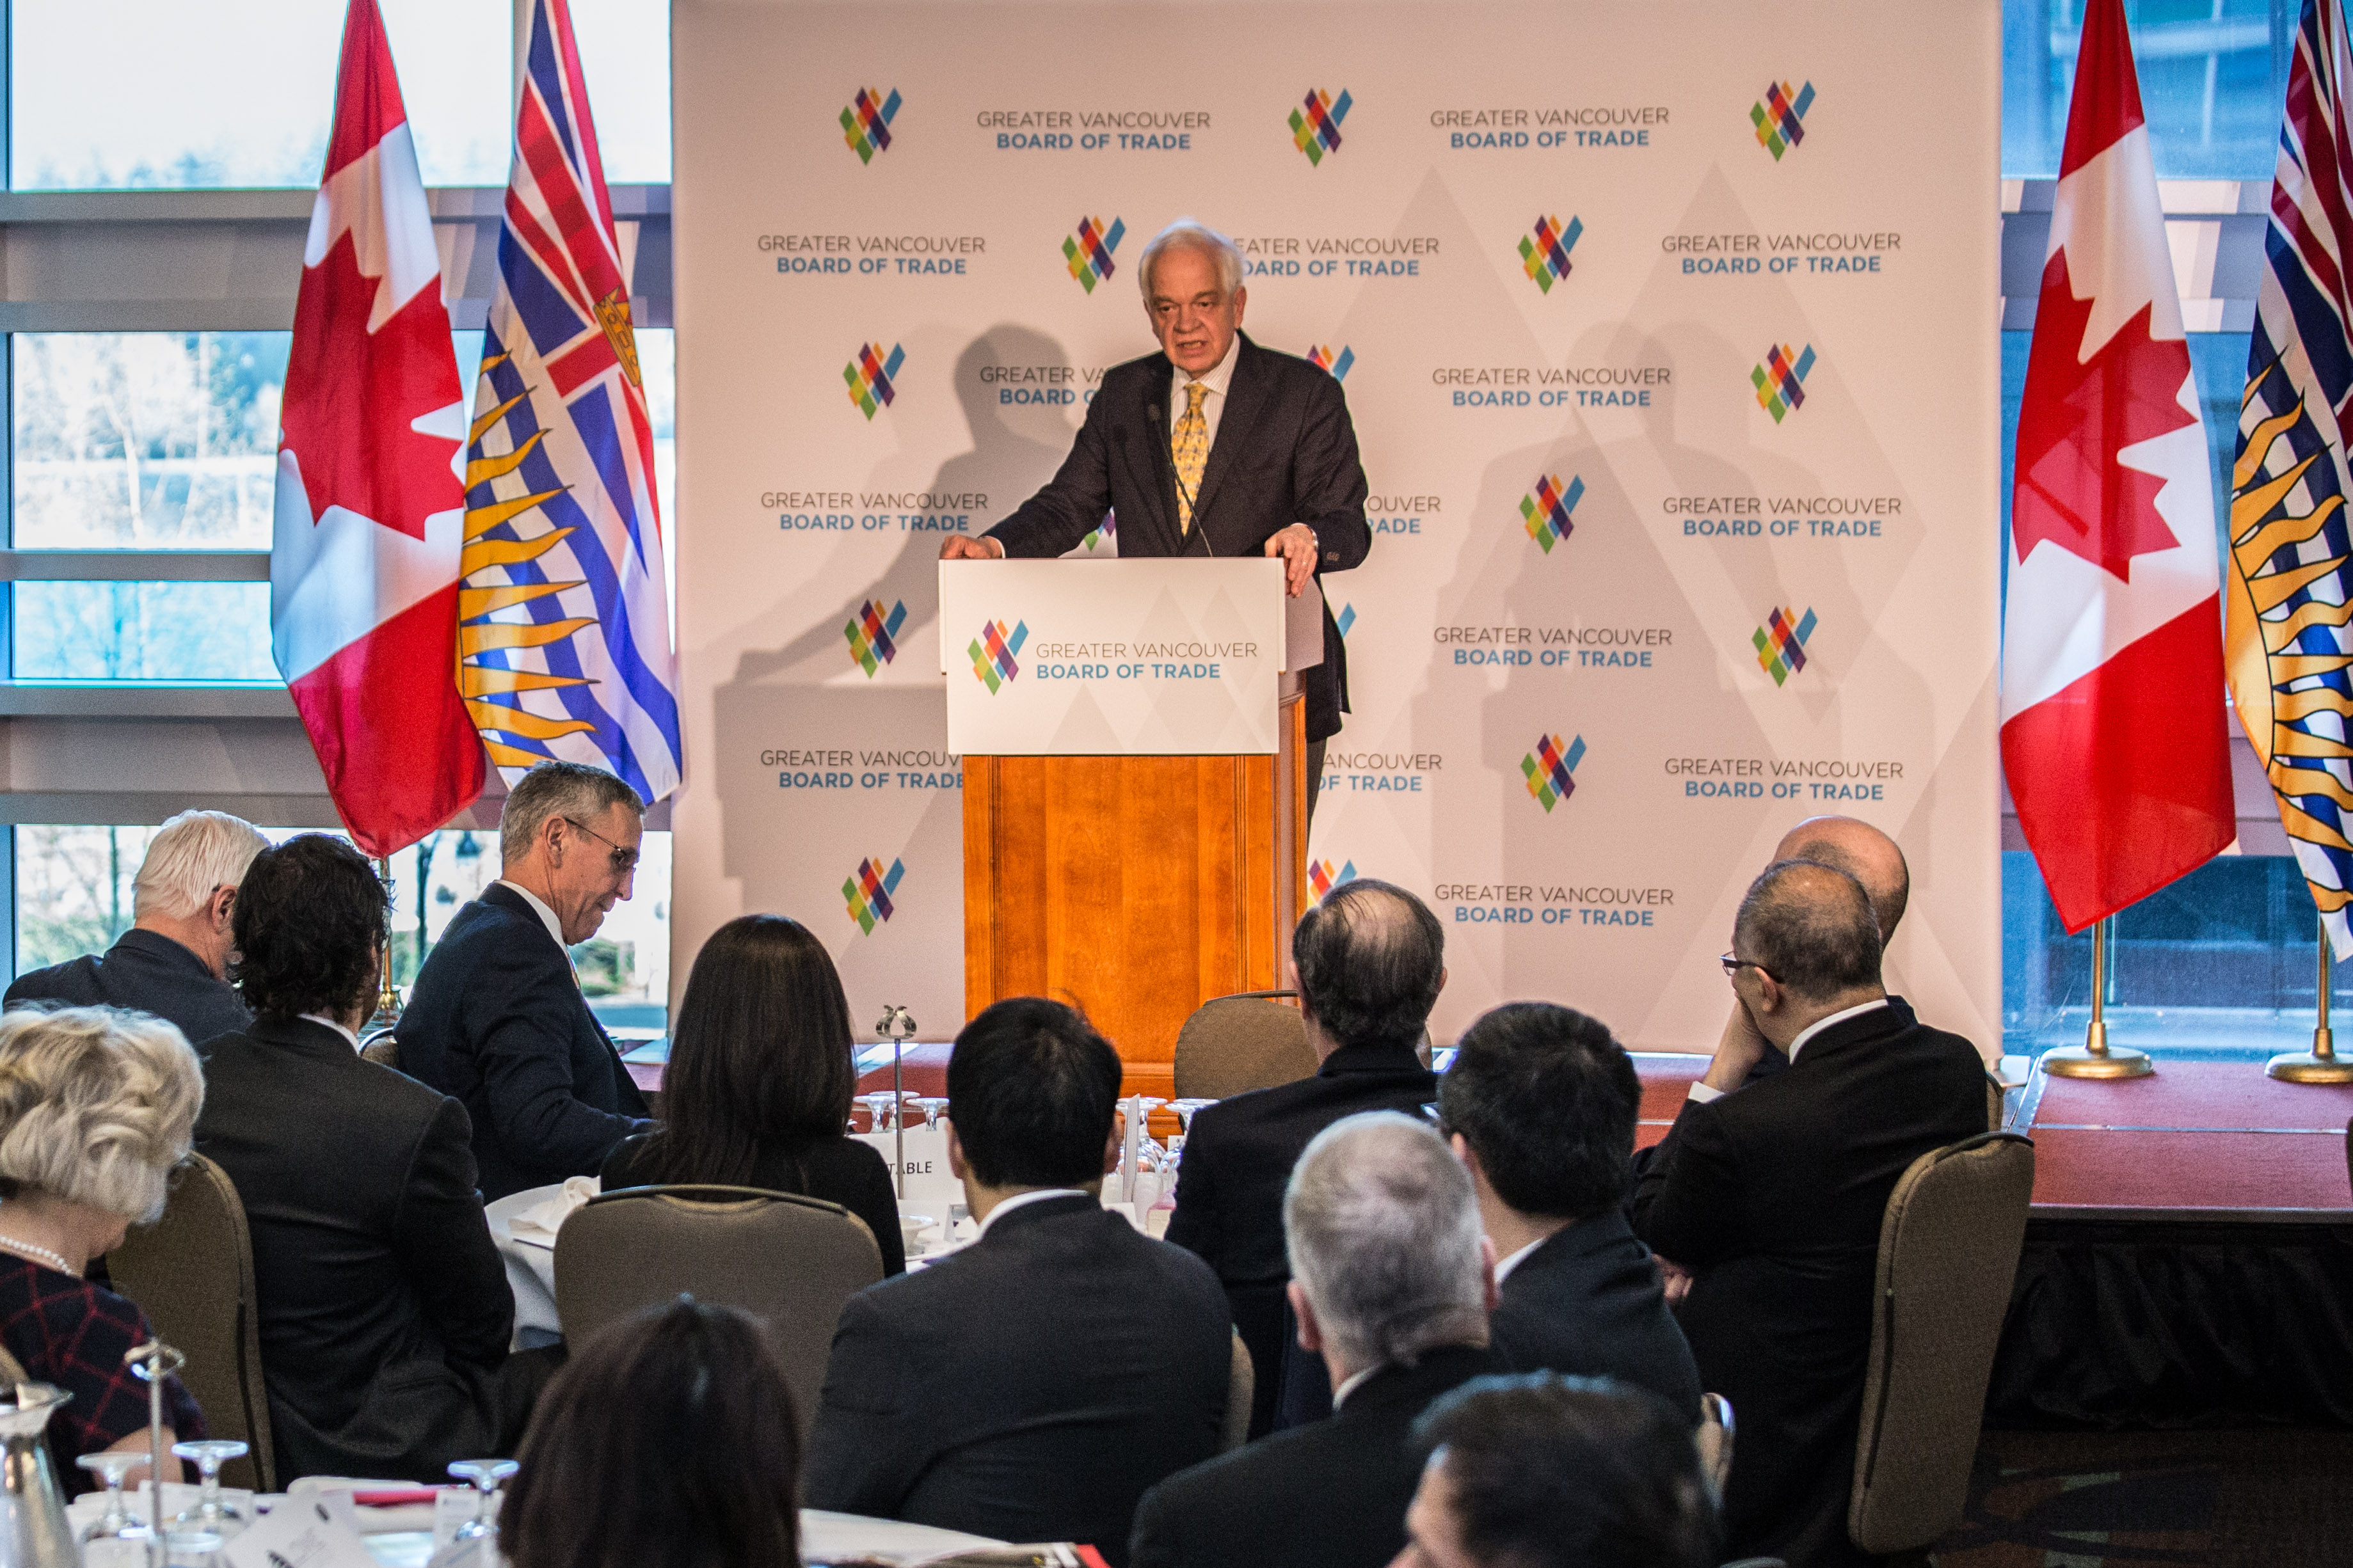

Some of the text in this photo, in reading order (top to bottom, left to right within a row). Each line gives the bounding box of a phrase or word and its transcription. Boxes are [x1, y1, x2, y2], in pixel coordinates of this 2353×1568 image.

[977, 111, 1211, 129] GREATER VANCOUVER
[1430, 107, 1670, 127] GREATER VANCOUVER
[996, 133, 1191, 150] BOARD OF TRADE
[1451, 130, 1649, 149] BOARD OF TRADE
[757, 234, 985, 253] GREATER VANCOUVER
[1306, 237, 1440, 255] VANCOUVER
[1661, 232, 1901, 253] GREATER VANCOUVER
[777, 257, 966, 275] BOARD OF TRADE
[1307, 260, 1337, 276] OF
[1346, 260, 1419, 276] TRADE
[1682, 256, 1881, 274] BOARD OF TRADE
[979, 366, 1074, 384] GREATER
[1432, 367, 1671, 385] GREATER VANCOUVER
[1000, 388, 1076, 405] BOARD
[1453, 390, 1651, 407] BOARD OF TRADE
[760, 491, 989, 510] GREATER VANCOUVER
[1367, 495, 1441, 512] OUVER
[1663, 496, 1902, 514] GREATER VANCOUVER
[779, 514, 969, 532] BOARD OF TRADE
[1683, 519, 1881, 537] BOARD OF TRADE
[1433, 626, 1673, 646] GREATER VANCOUVER
[1036, 642, 1257, 658] GREATER VANCOUVER
[1454, 649, 1652, 668] BOARD OF TRADE
[1037, 663, 1220, 679] BOARD OF TRADE
[760, 749, 959, 768] GREATER VANCOUV
[1322, 753, 1442, 770] ANCOUVER
[1664, 757, 1904, 779] GREATER VANCOUVER
[779, 772, 854, 789] BOARD
[860, 772, 889, 789] OF
[1348, 775, 1422, 792] TRADE
[1685, 780, 1884, 801] BOARD OF TRADE
[1434, 883, 1674, 905] GREATER VANCOUVER
[1455, 906, 1654, 927] BOARD OF TRADE
